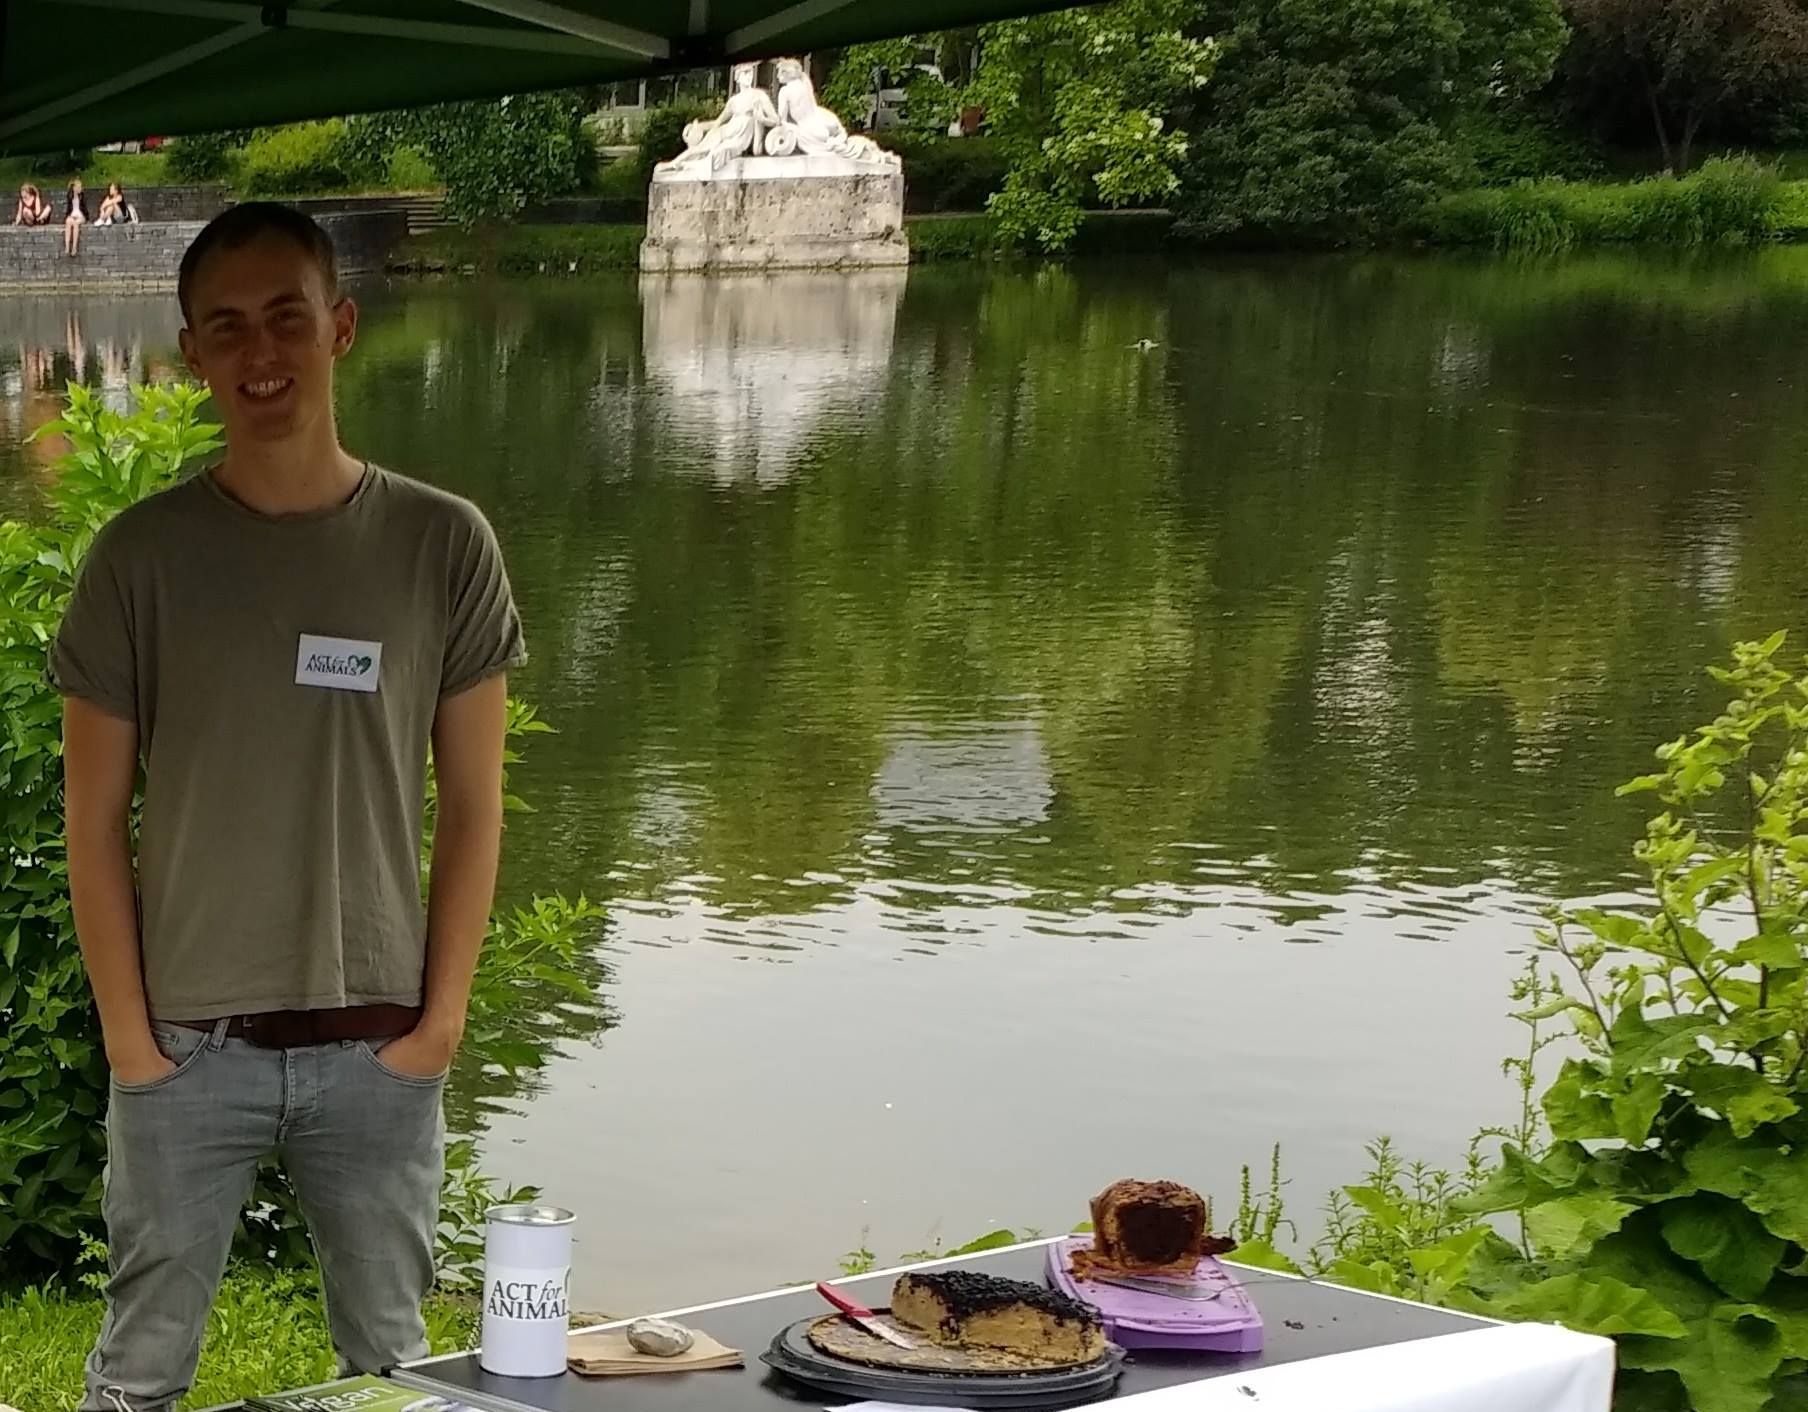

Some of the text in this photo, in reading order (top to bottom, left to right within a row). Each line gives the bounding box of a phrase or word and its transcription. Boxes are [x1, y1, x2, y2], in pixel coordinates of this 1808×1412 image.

[305, 662, 357, 676] ANIMALS
[492, 1279, 562, 1307] ACT for
